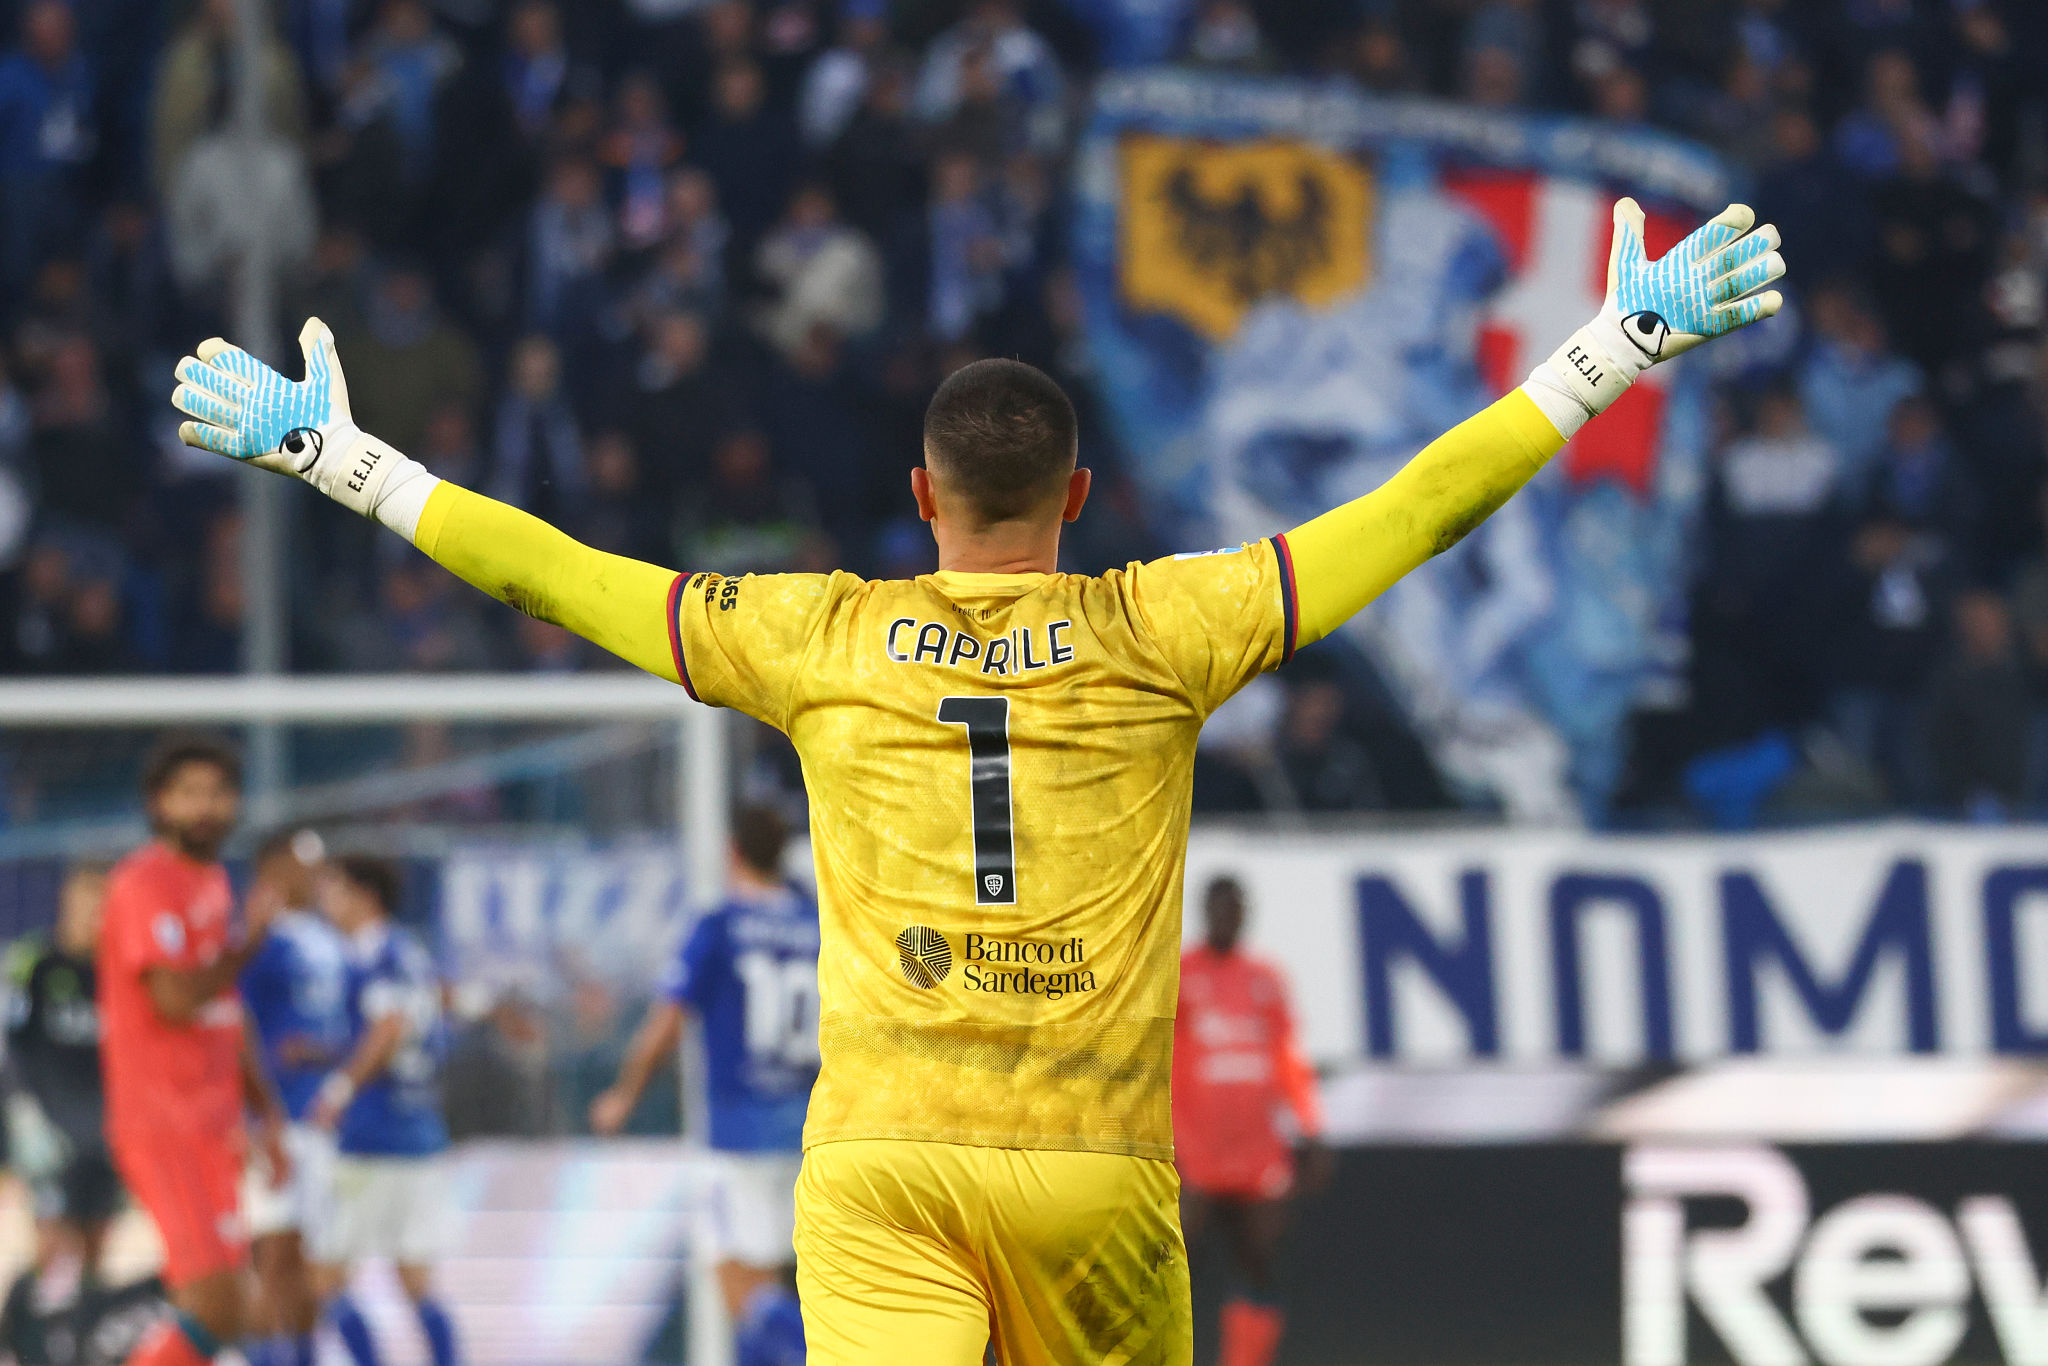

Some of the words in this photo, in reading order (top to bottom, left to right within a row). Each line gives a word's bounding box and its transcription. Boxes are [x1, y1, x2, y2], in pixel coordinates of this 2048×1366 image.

[1567, 346, 1603, 387] E.E.J.L
[347, 451, 381, 493] E.E.J.L
[886, 617, 1074, 676] CAPRILE
[936, 696, 1017, 905] 1
[964, 933, 1054, 964] Banco
[1060, 938, 1084, 964] di
[964, 964, 1097, 1000] Sardegna
